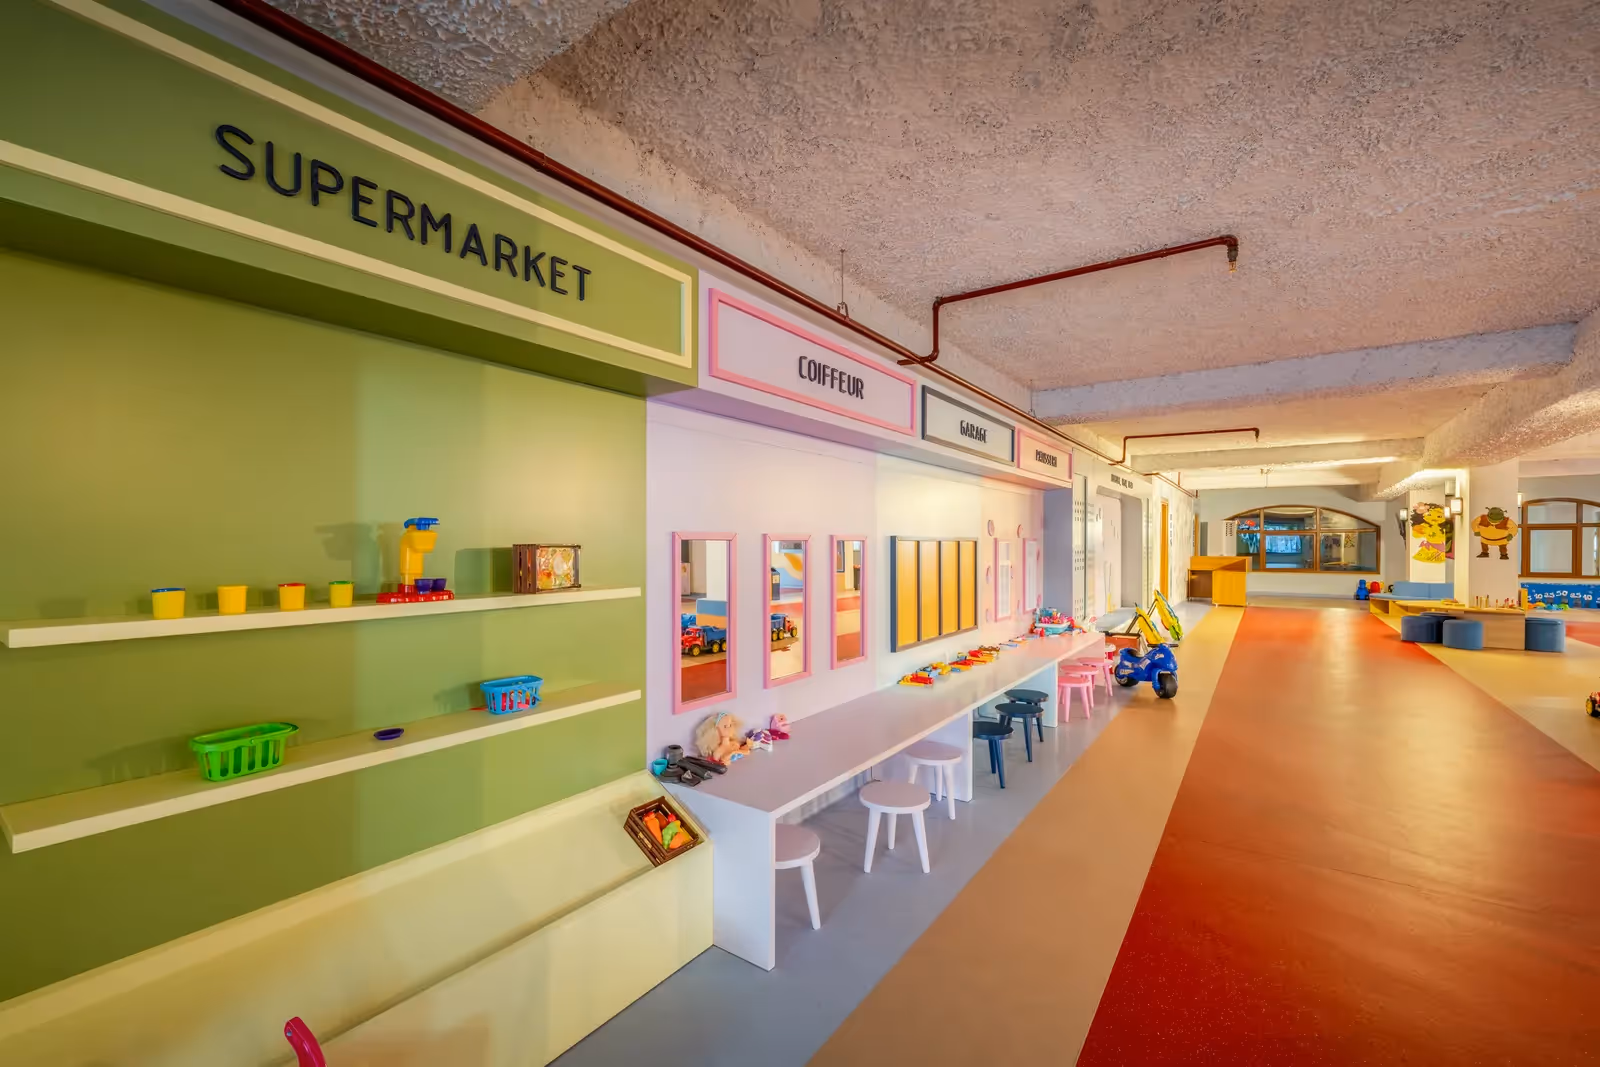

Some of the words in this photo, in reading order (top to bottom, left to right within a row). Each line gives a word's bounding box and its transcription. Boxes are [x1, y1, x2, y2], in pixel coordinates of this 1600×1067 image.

[215, 124, 592, 301] SUPERMARKET
[798, 355, 865, 400] COIFFEUR
[960, 419, 988, 444] GARAGE
